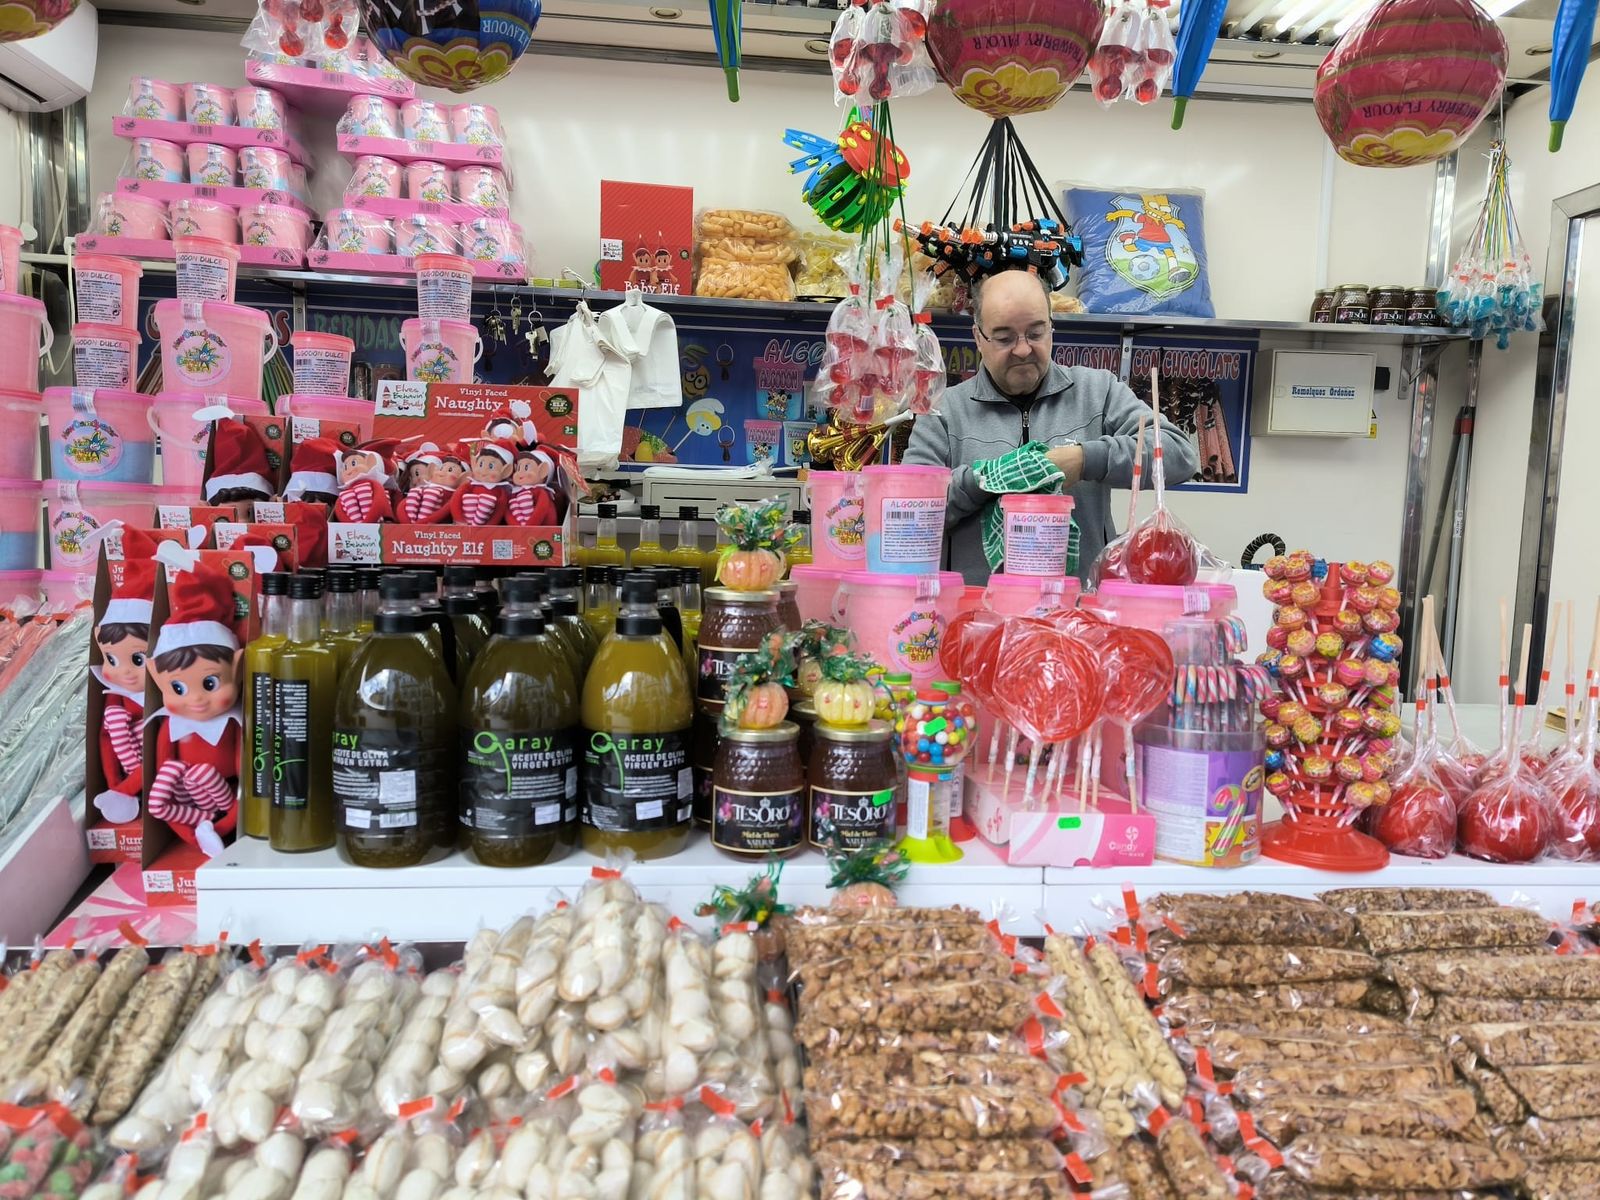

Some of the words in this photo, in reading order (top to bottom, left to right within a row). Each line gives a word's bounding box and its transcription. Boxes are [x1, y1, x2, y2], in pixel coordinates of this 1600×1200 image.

[623, 281, 657, 294] Baby
[661, 283, 680, 295] Elf
[314, 313, 402, 350] BEBIDAS
[764, 338, 826, 366] ALGO
[1054, 345, 1120, 374] GOLOSINA
[1133, 348, 1160, 378] CON
[1163, 351, 1241, 380] CHOCOLATE
[395, 384, 418, 394] Elves
[460, 387, 482, 397] Vinyl
[484, 389, 508, 397] Faced
[1291, 386, 1326, 397] Remolques
[434, 396, 503, 412] Naughty
[890, 500, 929, 509] ALGODON
[1012, 513, 1050, 523] ALGODON
[346, 530, 371, 541] Elves
[414, 530, 436, 541] Vinyl
[439, 531, 461, 540] Faced
[392, 540, 458, 557] Naughty
[461, 542, 484, 556] Elf
[332, 731, 359, 750] ray
[352, 751, 362, 759] DE
[512, 753, 544, 762] ACEITE
[545, 752, 556, 760] DE
[624, 753, 655, 762] ACEITE
[656, 752, 667, 761] DE
[358, 759, 390, 767] EXTRA
[512, 760, 549, 770] VIRGEN
[624, 761, 660, 770] VIRGEN
[731, 803, 791, 823] TESORO
[829, 803, 888, 823] TESORO
[1109, 841, 1138, 852] Candy
